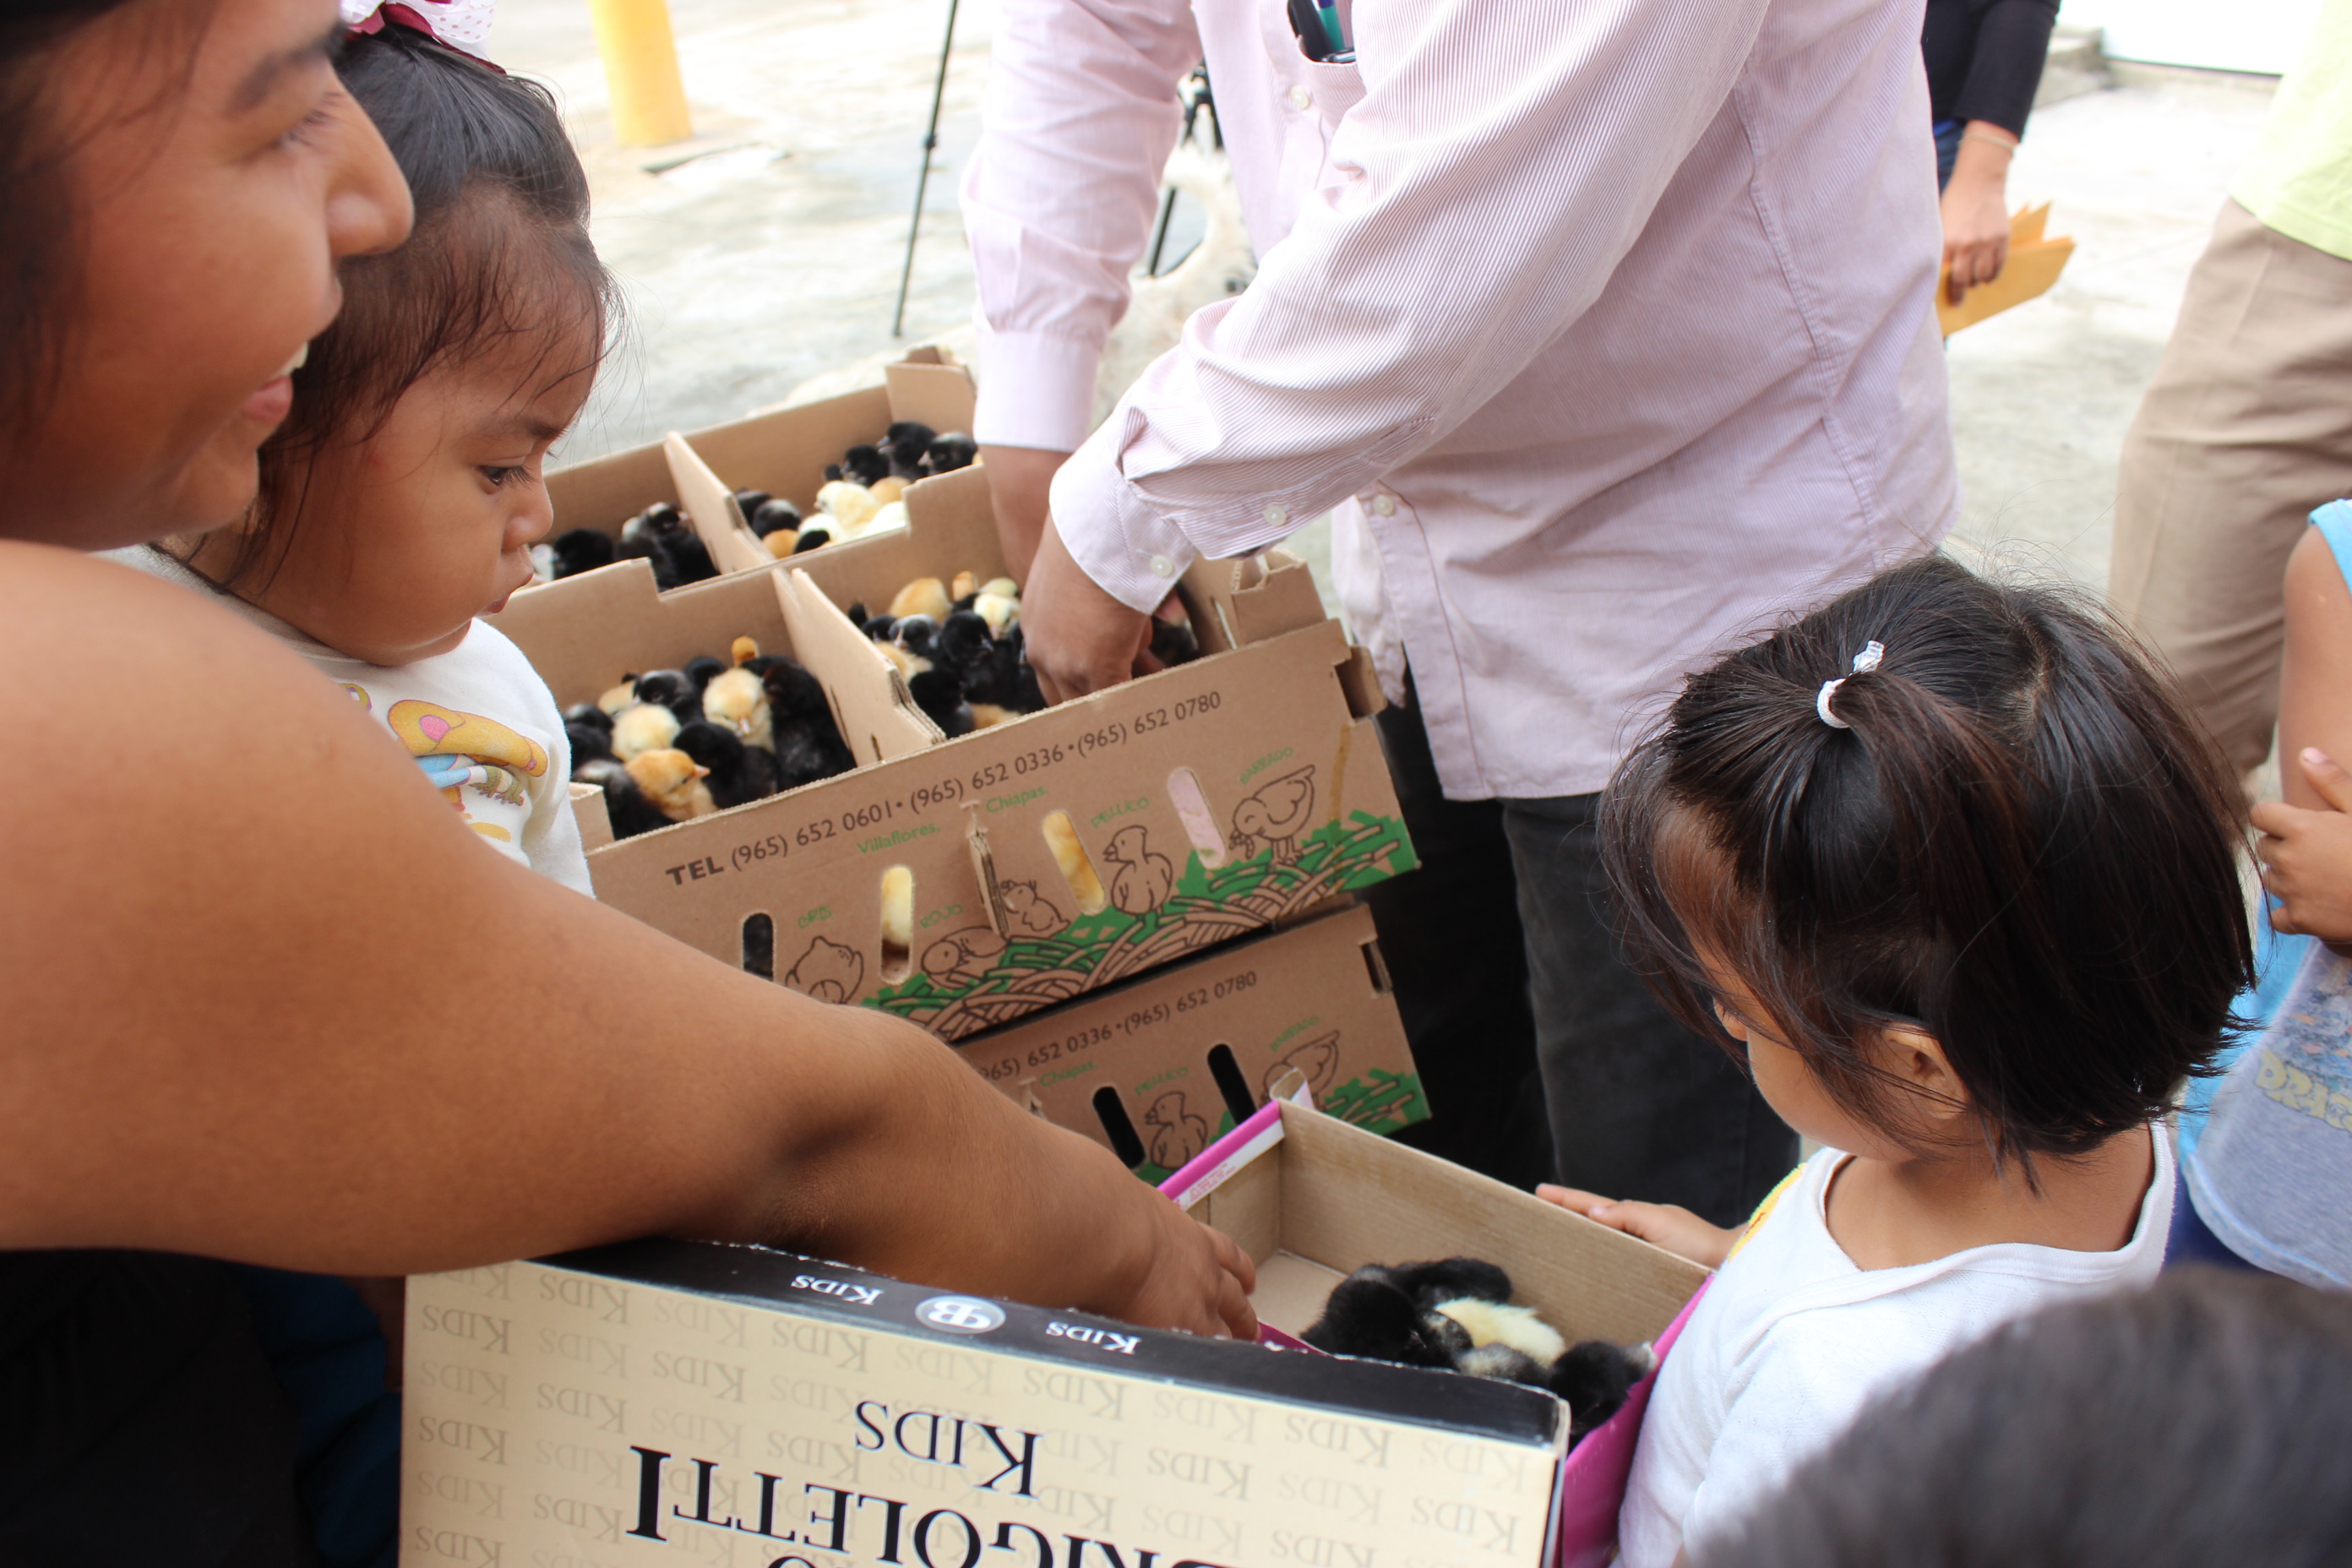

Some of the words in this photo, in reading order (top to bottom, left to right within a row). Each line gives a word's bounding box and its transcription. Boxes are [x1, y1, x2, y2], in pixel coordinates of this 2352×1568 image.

[666, 856, 724, 885] TEL
[732, 834, 788, 872] (965)
[796, 819, 836, 847] 652
[911, 778, 964, 815] (965)
[972, 763, 1009, 790] 652
[1077, 723, 1127, 759] (965)
[1134, 708, 1169, 734] 652
[1174, 691, 1221, 721] 0780
[797, 904, 834, 930] GRIS
[1028, 1043, 1062, 1067] 652
[1124, 1001, 1171, 1036] (965)
[1177, 988, 1209, 1013] 652
[1213, 970, 1257, 999] 0780
[791, 1274, 885, 1306] KIDS
[1045, 1321, 1143, 1355] KIDS
[854, 1399, 1043, 1499] KIDS
